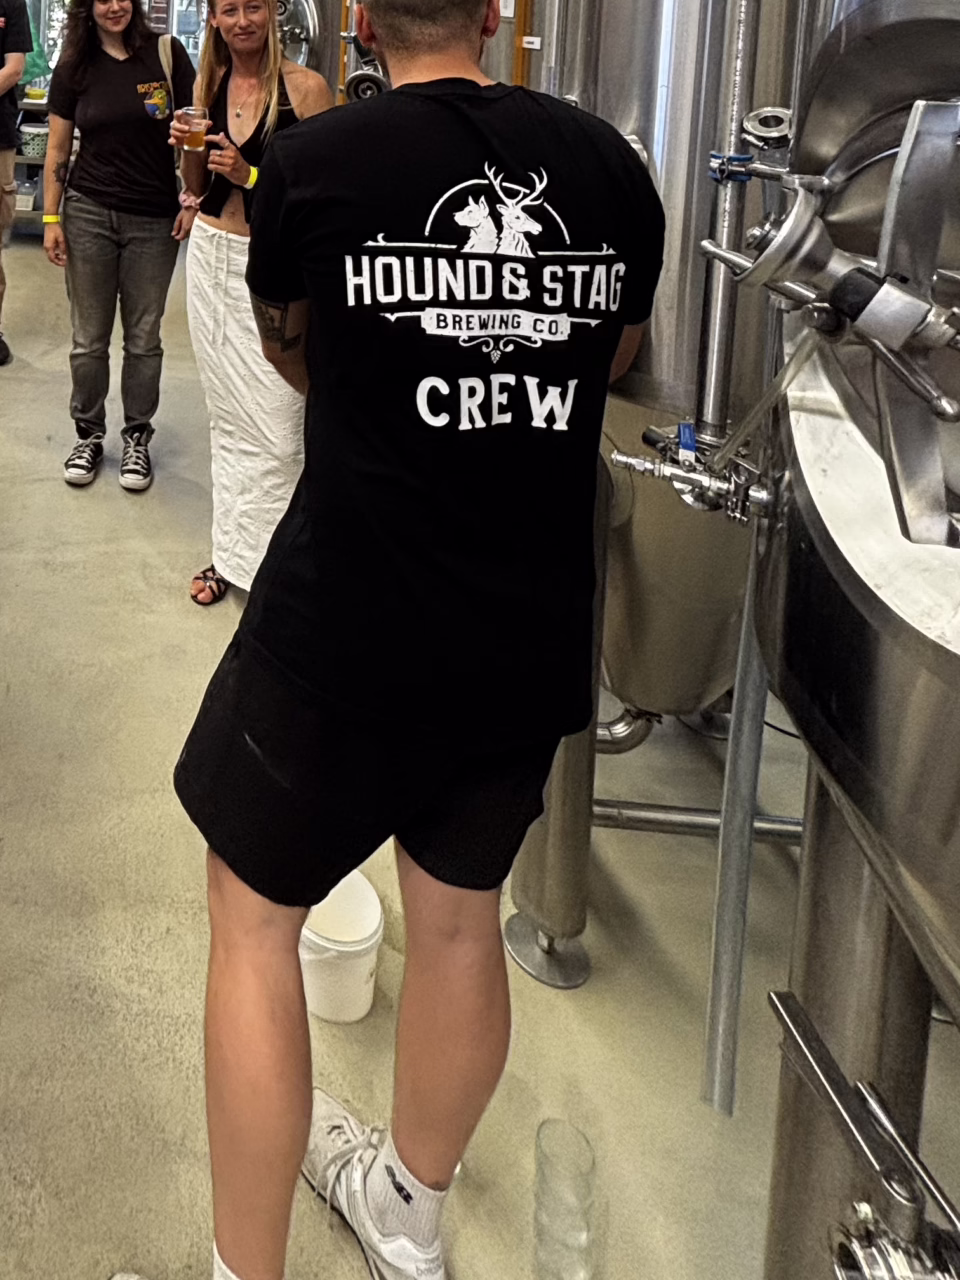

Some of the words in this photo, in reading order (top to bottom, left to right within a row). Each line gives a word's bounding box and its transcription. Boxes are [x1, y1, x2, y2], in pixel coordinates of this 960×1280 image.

[345, 255, 493, 306] HOUND
[502, 262, 531, 301] &
[542, 262, 626, 311] STAG
[436, 313, 521, 331] BREWING
[532, 318, 564, 335] CO.
[416, 374, 578, 430] CREW
